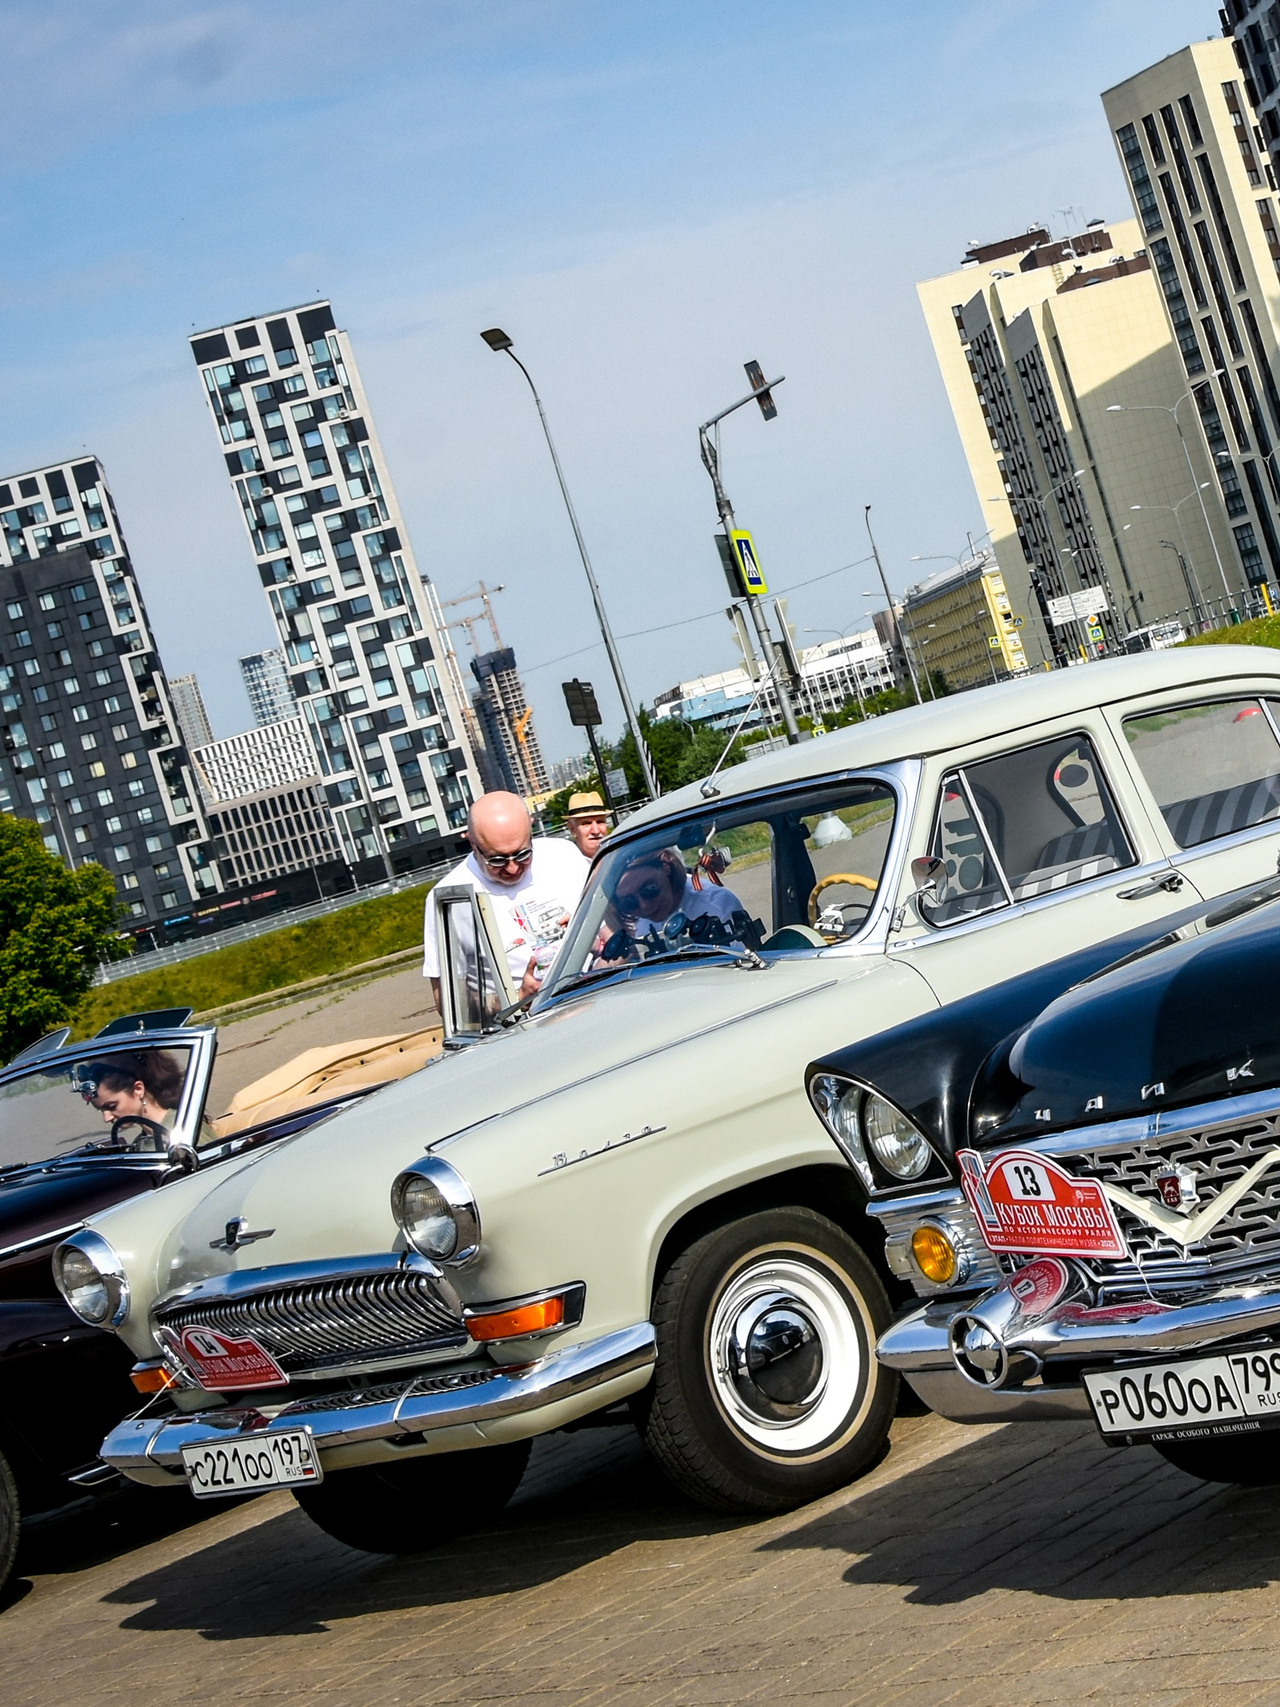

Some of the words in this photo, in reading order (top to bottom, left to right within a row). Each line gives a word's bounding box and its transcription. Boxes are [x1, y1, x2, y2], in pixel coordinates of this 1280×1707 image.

[1014, 1166, 1041, 1196] 13
[995, 1202, 1045, 1226] КУБОК
[1041, 1204, 1109, 1228] МОСКВЫ
[194, 1335, 219, 1354] 14
[1100, 1371, 1238, 1425] Р060ОА
[1151, 1432, 1175, 1441] ГАРАЖ
[1176, 1427, 1210, 1438] ОСОБОГО
[1212, 1421, 1261, 1434] НАЗНАЧЕНИЯ
[194, 1447, 273, 1487] С221ОО
[272, 1435, 304, 1466] 197
[286, 1466, 302, 1477] RUS
